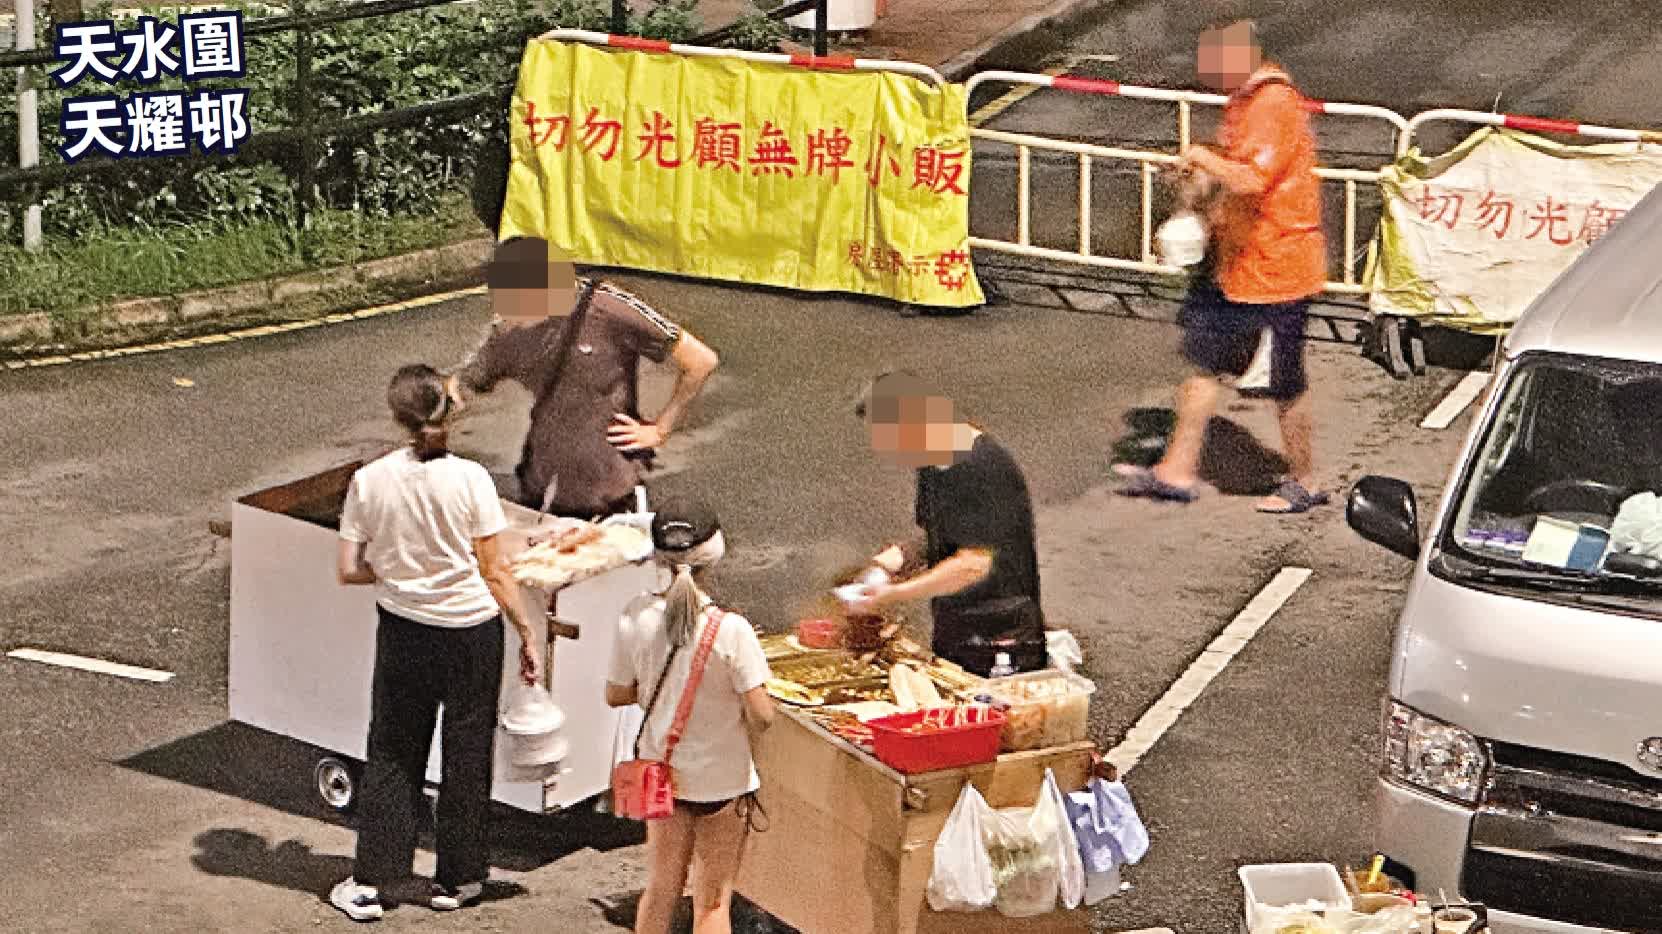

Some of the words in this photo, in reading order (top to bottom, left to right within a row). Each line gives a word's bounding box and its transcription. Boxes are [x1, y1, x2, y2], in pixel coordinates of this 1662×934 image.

[523, 101, 968, 195] 切勿光顧無牌小販
